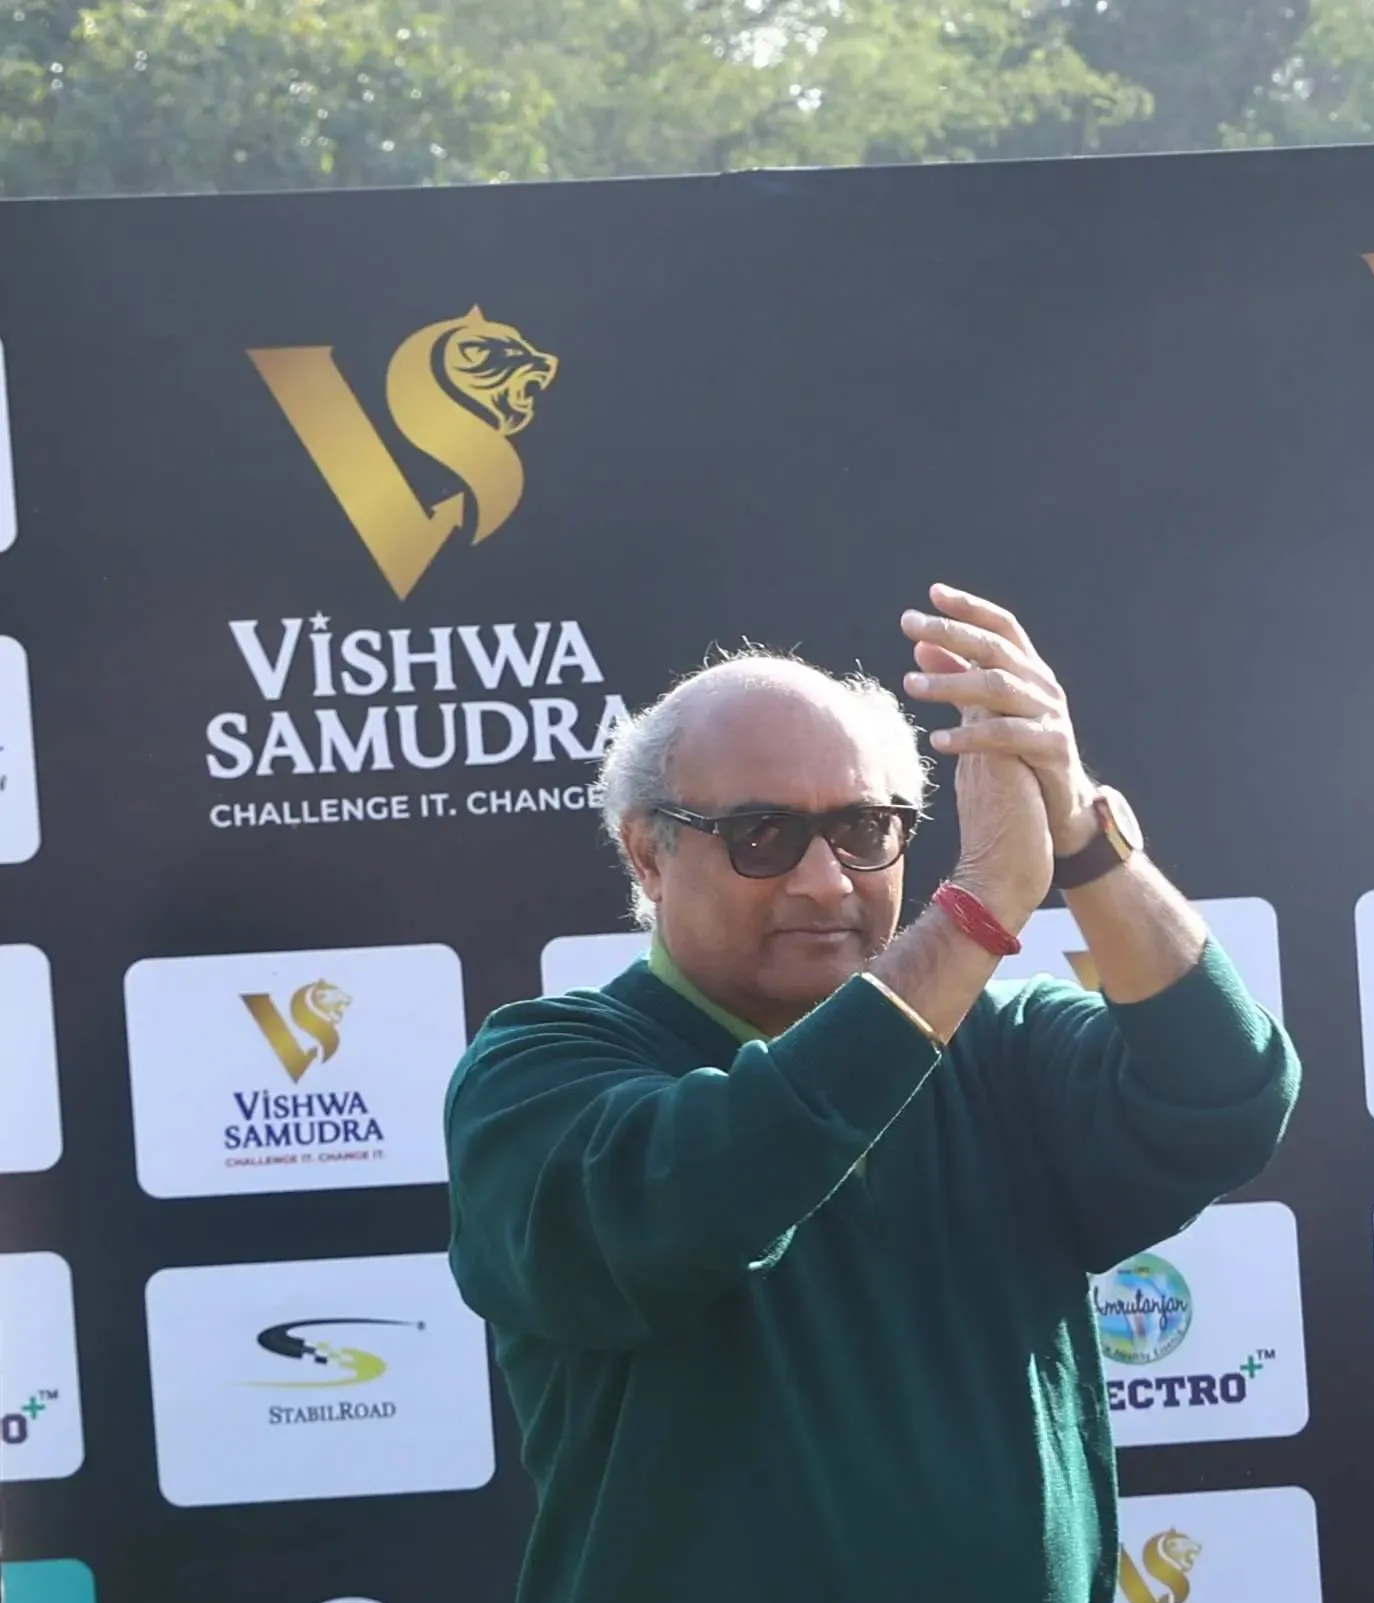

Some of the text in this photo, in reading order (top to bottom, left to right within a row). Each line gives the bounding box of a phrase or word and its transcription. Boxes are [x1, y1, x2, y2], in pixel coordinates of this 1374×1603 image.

[228, 610, 604, 700] VISHWA
[206, 694, 634, 779] SAMUDRA
[209, 786, 606, 828] CHALLENGE IT. CHANGE
[233, 1089, 369, 1121] VISHWA
[224, 1118, 385, 1149] SAMUDRA
